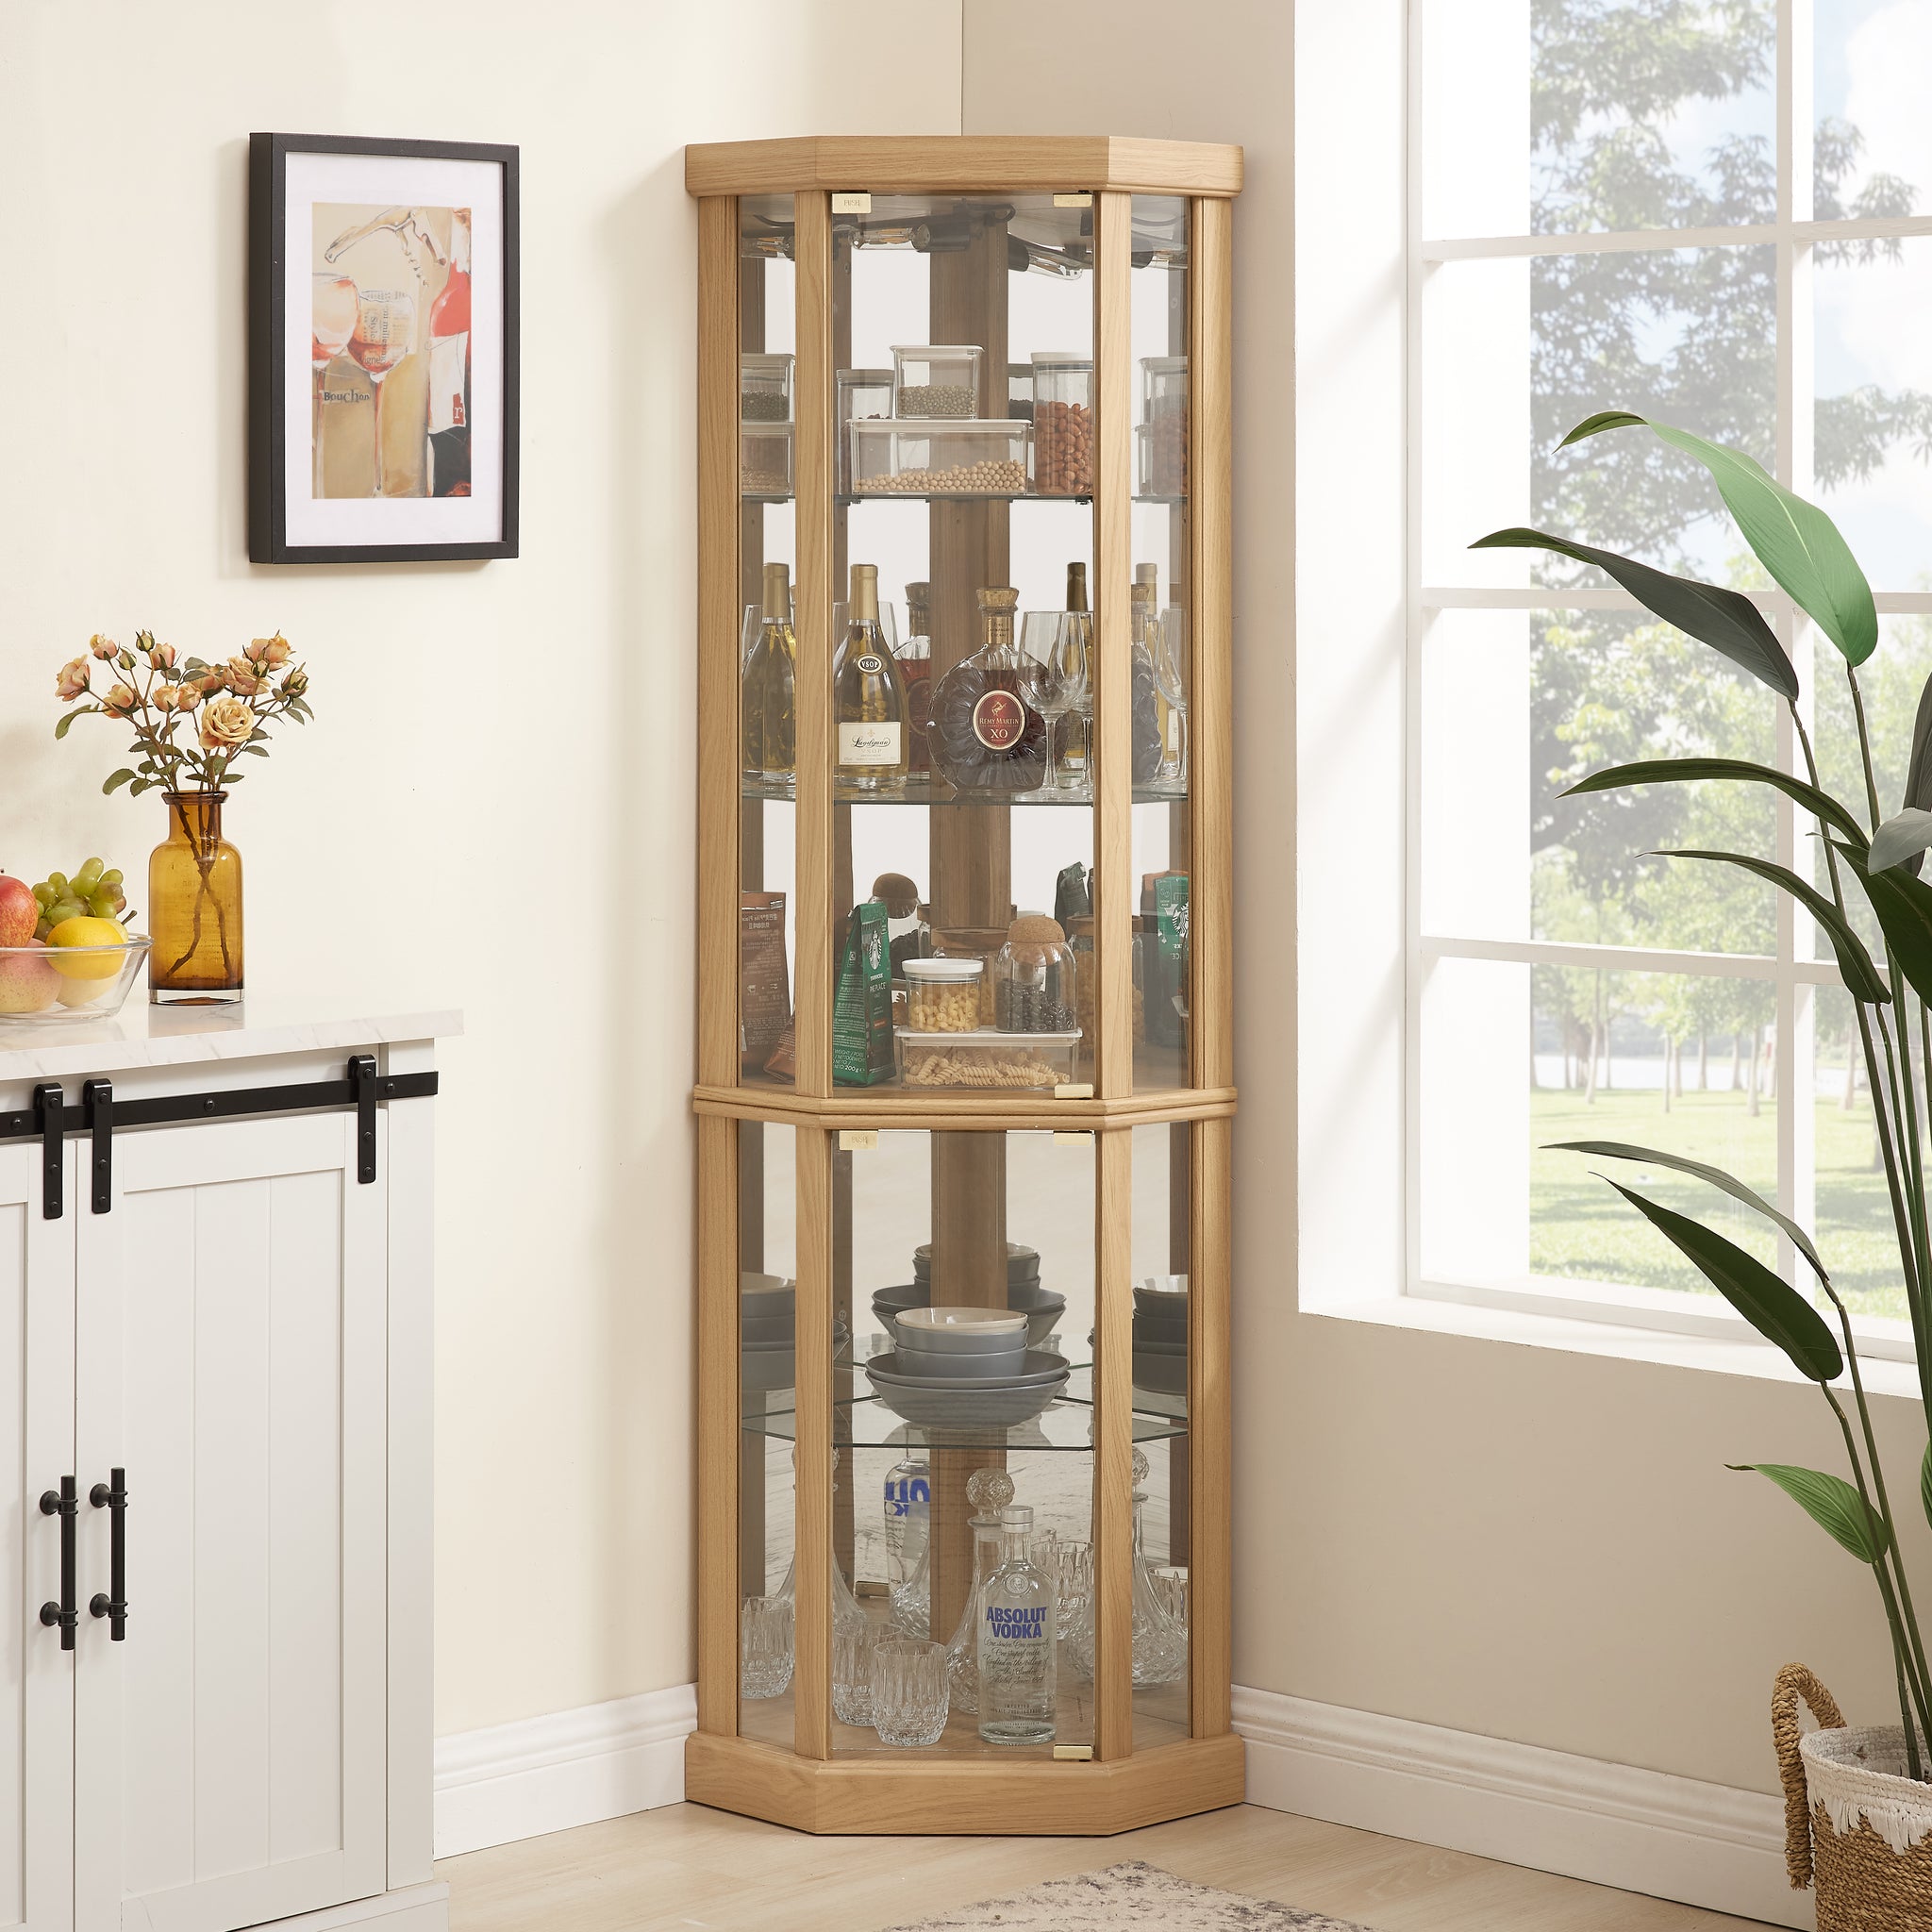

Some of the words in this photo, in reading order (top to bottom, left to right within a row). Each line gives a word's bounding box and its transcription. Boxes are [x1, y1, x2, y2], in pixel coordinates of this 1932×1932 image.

[324, 389, 370, 403] Bouchon
[991, 728, 1008, 739] XO
[987, 1607, 1047, 1624] ABSOLUT
[991, 1623, 1042, 1639] VODKA
